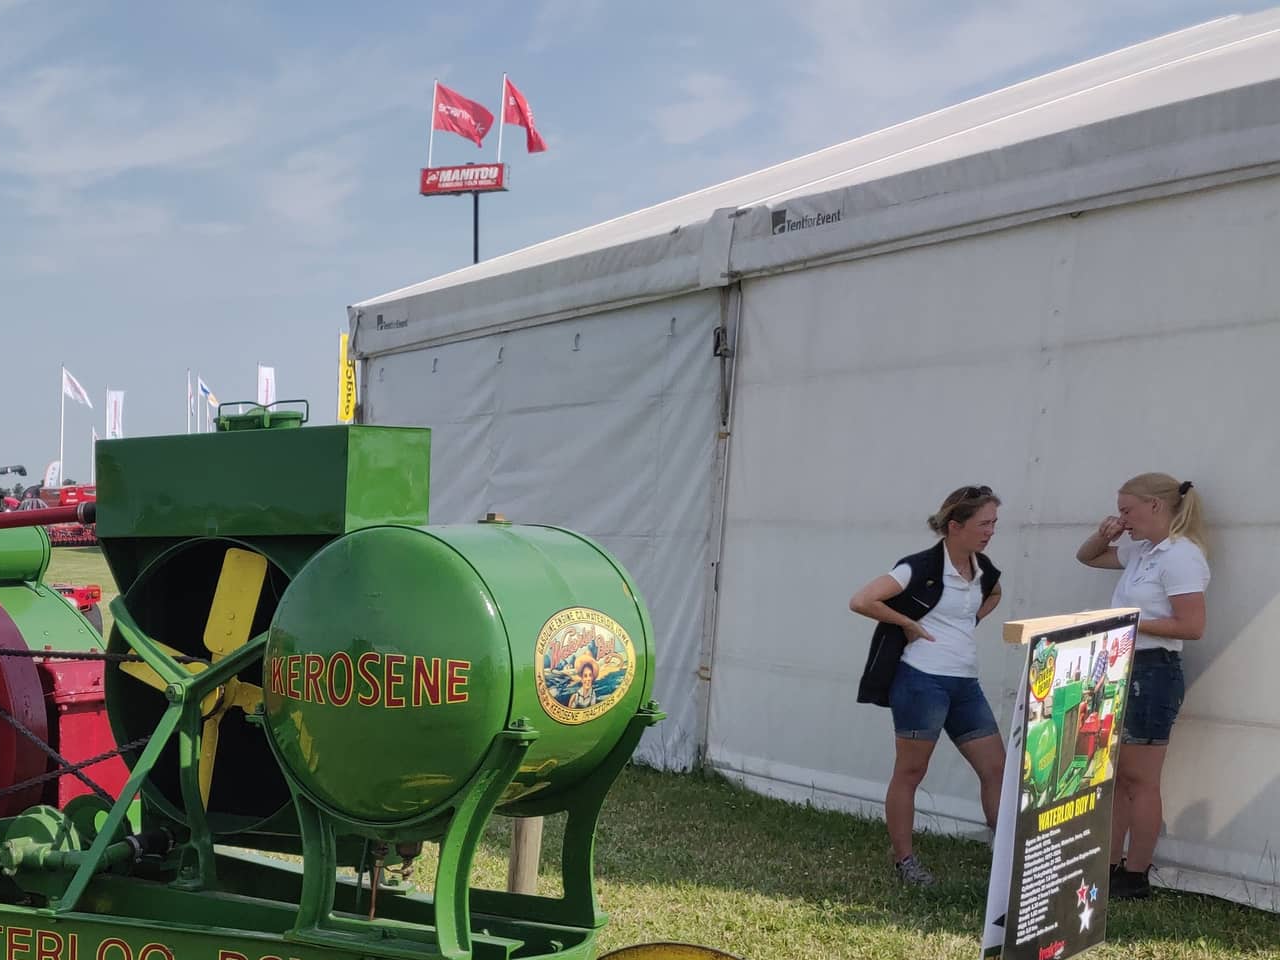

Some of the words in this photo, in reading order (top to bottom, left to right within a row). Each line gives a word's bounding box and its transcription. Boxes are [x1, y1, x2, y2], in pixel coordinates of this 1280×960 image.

[439, 167, 499, 182] MANITOU
[271, 651, 471, 709] KEROSENE
[1038, 801, 1075, 832] WATERLOO
[1075, 794, 1090, 817] BOY
